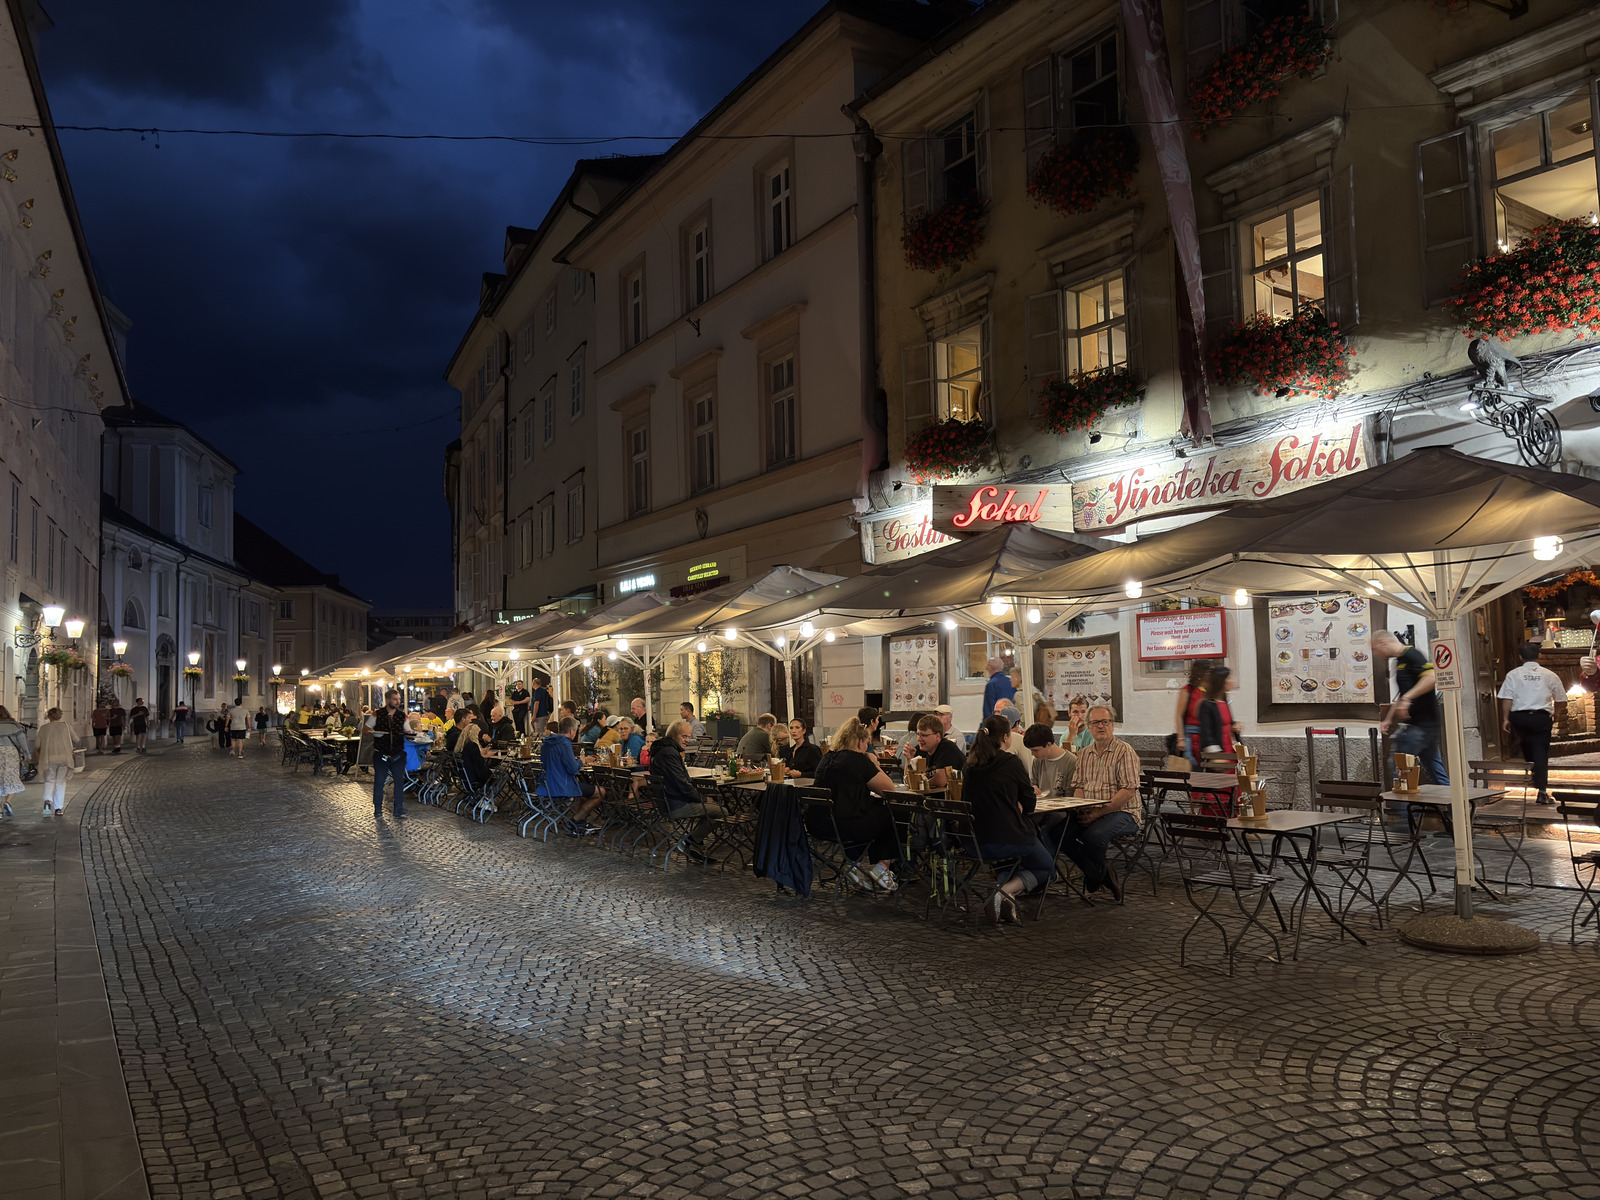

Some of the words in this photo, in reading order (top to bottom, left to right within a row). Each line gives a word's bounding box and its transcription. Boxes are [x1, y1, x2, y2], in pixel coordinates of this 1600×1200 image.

[1107, 456, 1242, 524] Vinoteka
[1253, 423, 1362, 497] Sokol
[953, 486, 1049, 527] Sokol
[1167, 643, 1183, 651] aspetta
